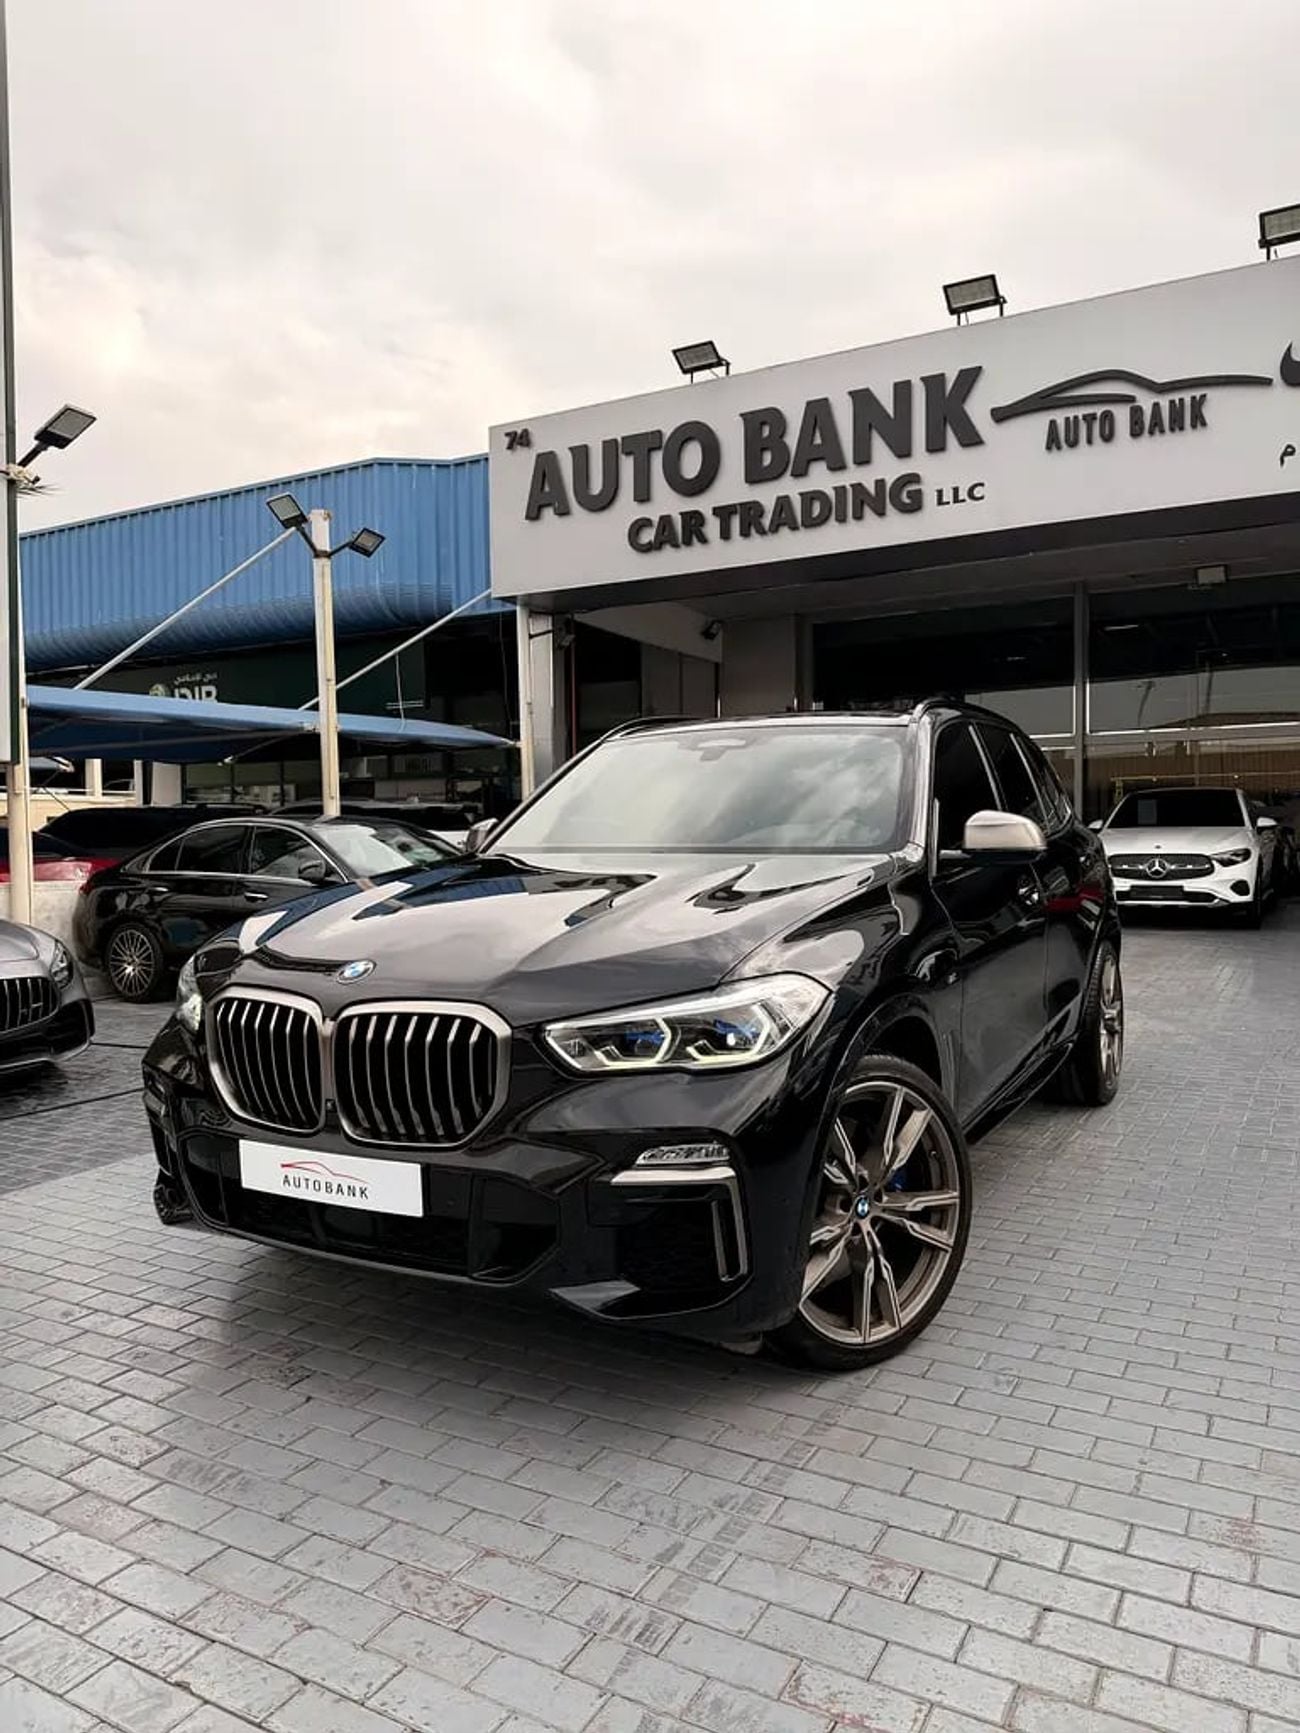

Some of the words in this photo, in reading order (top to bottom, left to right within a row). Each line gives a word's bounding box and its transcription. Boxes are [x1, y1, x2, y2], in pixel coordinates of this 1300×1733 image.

[504, 428, 532, 451] 74
[524, 420, 721, 522] AUTO
[739, 365, 986, 486] BANK
[1045, 409, 1116, 453] AUTO
[1129, 393, 1208, 440] BANK
[627, 509, 709, 554] CAR
[711, 472, 924, 543] TRADING
[935, 482, 985, 507] LLC
[282, 1174, 370, 1200] AUTOBANK
